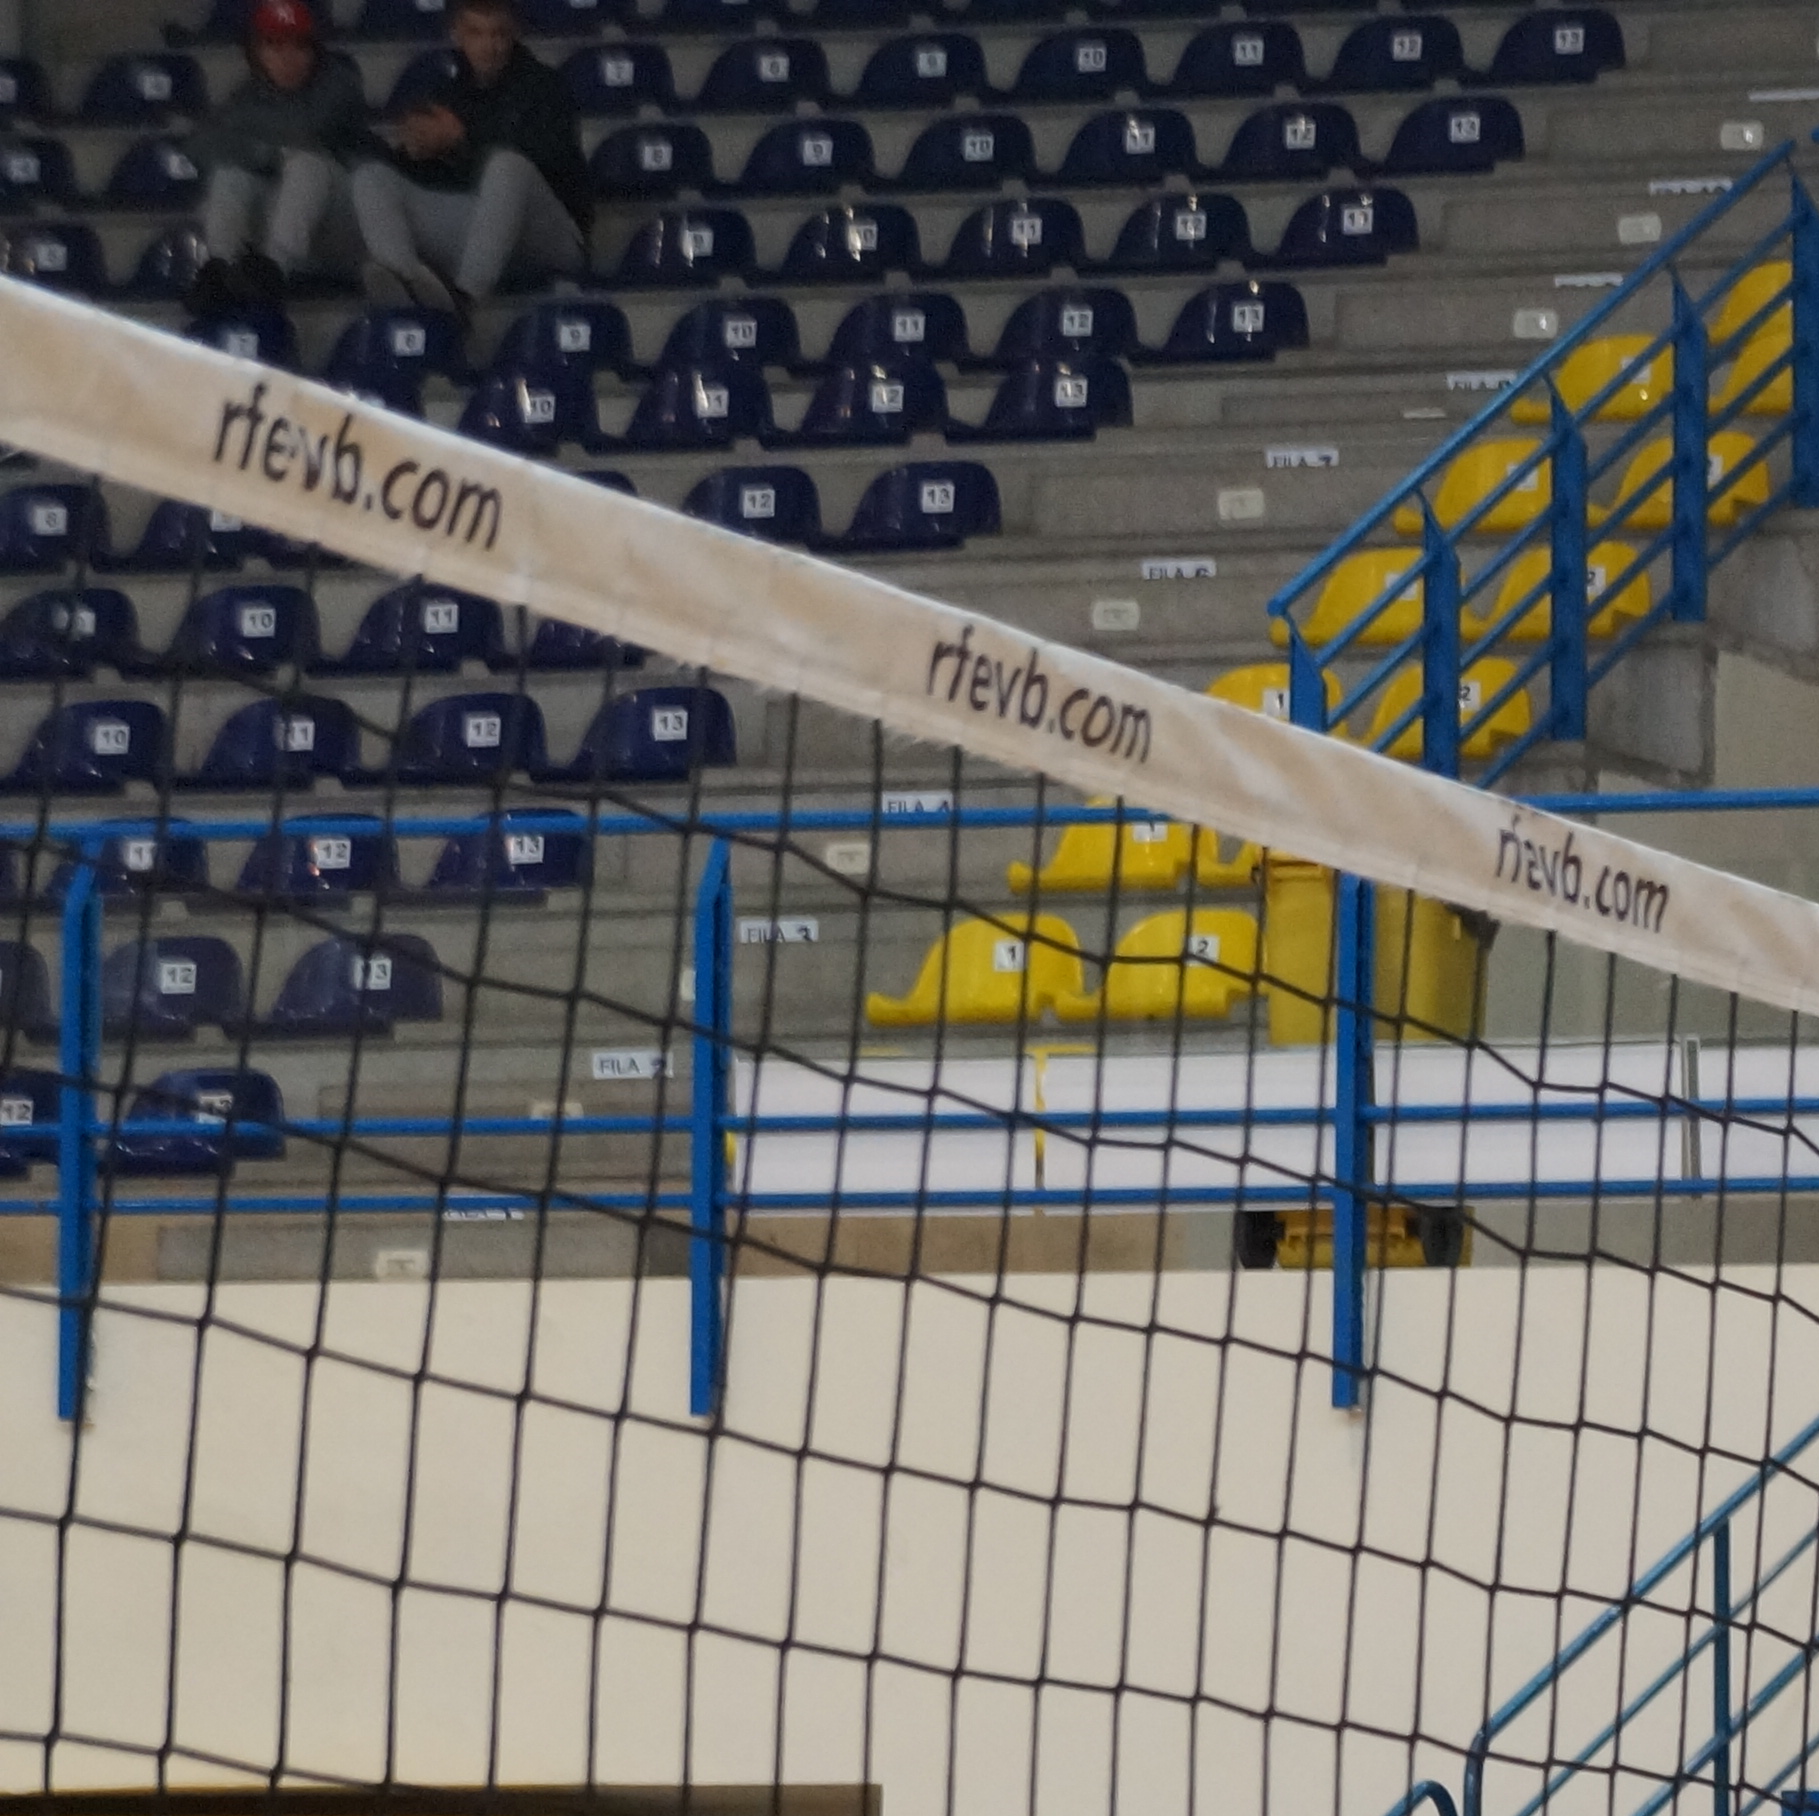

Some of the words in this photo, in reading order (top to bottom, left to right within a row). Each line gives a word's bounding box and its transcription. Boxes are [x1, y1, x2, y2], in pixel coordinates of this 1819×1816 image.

[212, 381, 503, 550] rfevb.com
[927, 624, 1152, 764] rfevb.com
[600, 1059, 642, 1075] FILA
